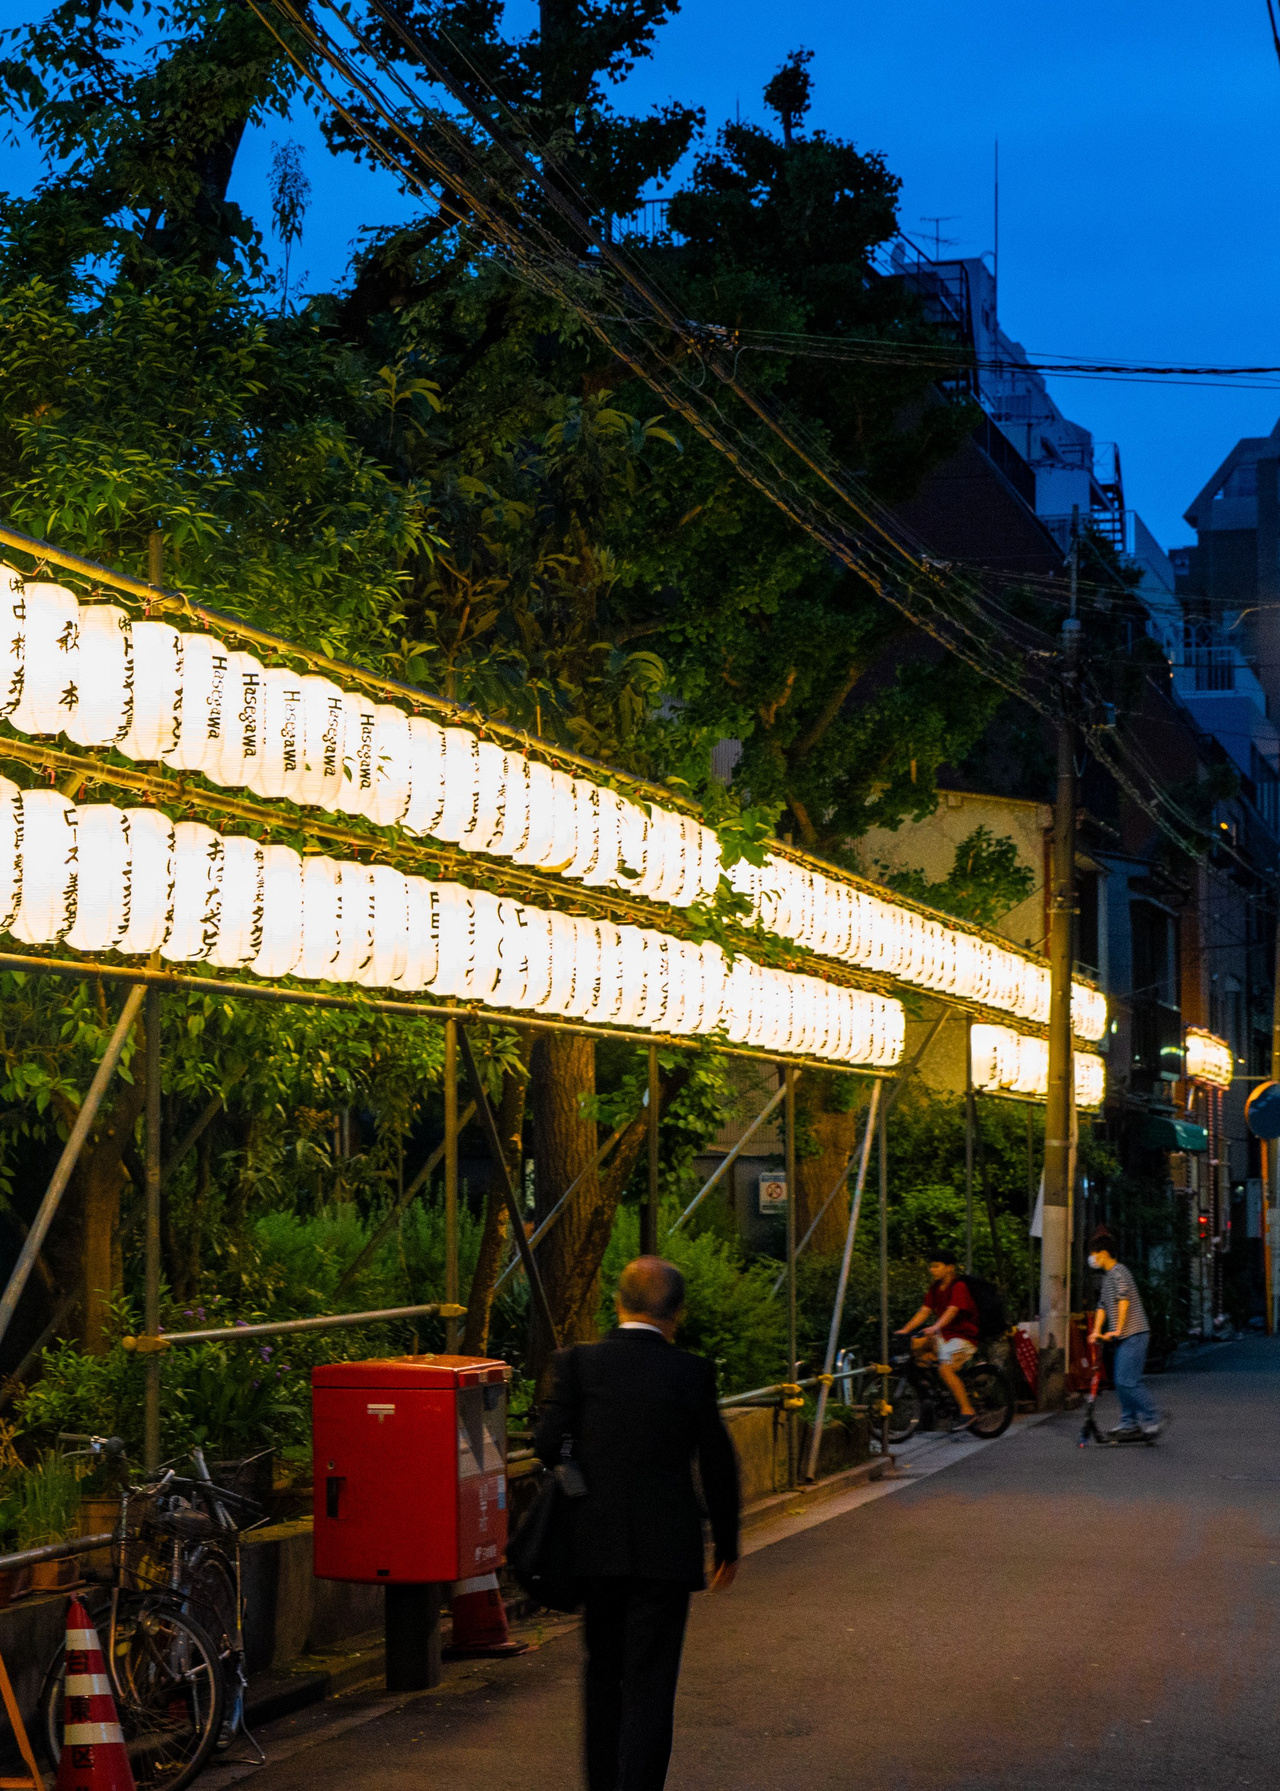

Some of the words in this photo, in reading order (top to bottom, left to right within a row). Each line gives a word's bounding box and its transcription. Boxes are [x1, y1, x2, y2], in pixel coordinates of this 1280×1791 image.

[207, 655, 228, 739] Hasegawa
[238, 672, 261, 759] Hasegawa
[280, 690, 302, 773] Hasegawa
[322, 697, 342, 777] Hasegawa
[356, 713, 375, 790] Hasegawa
